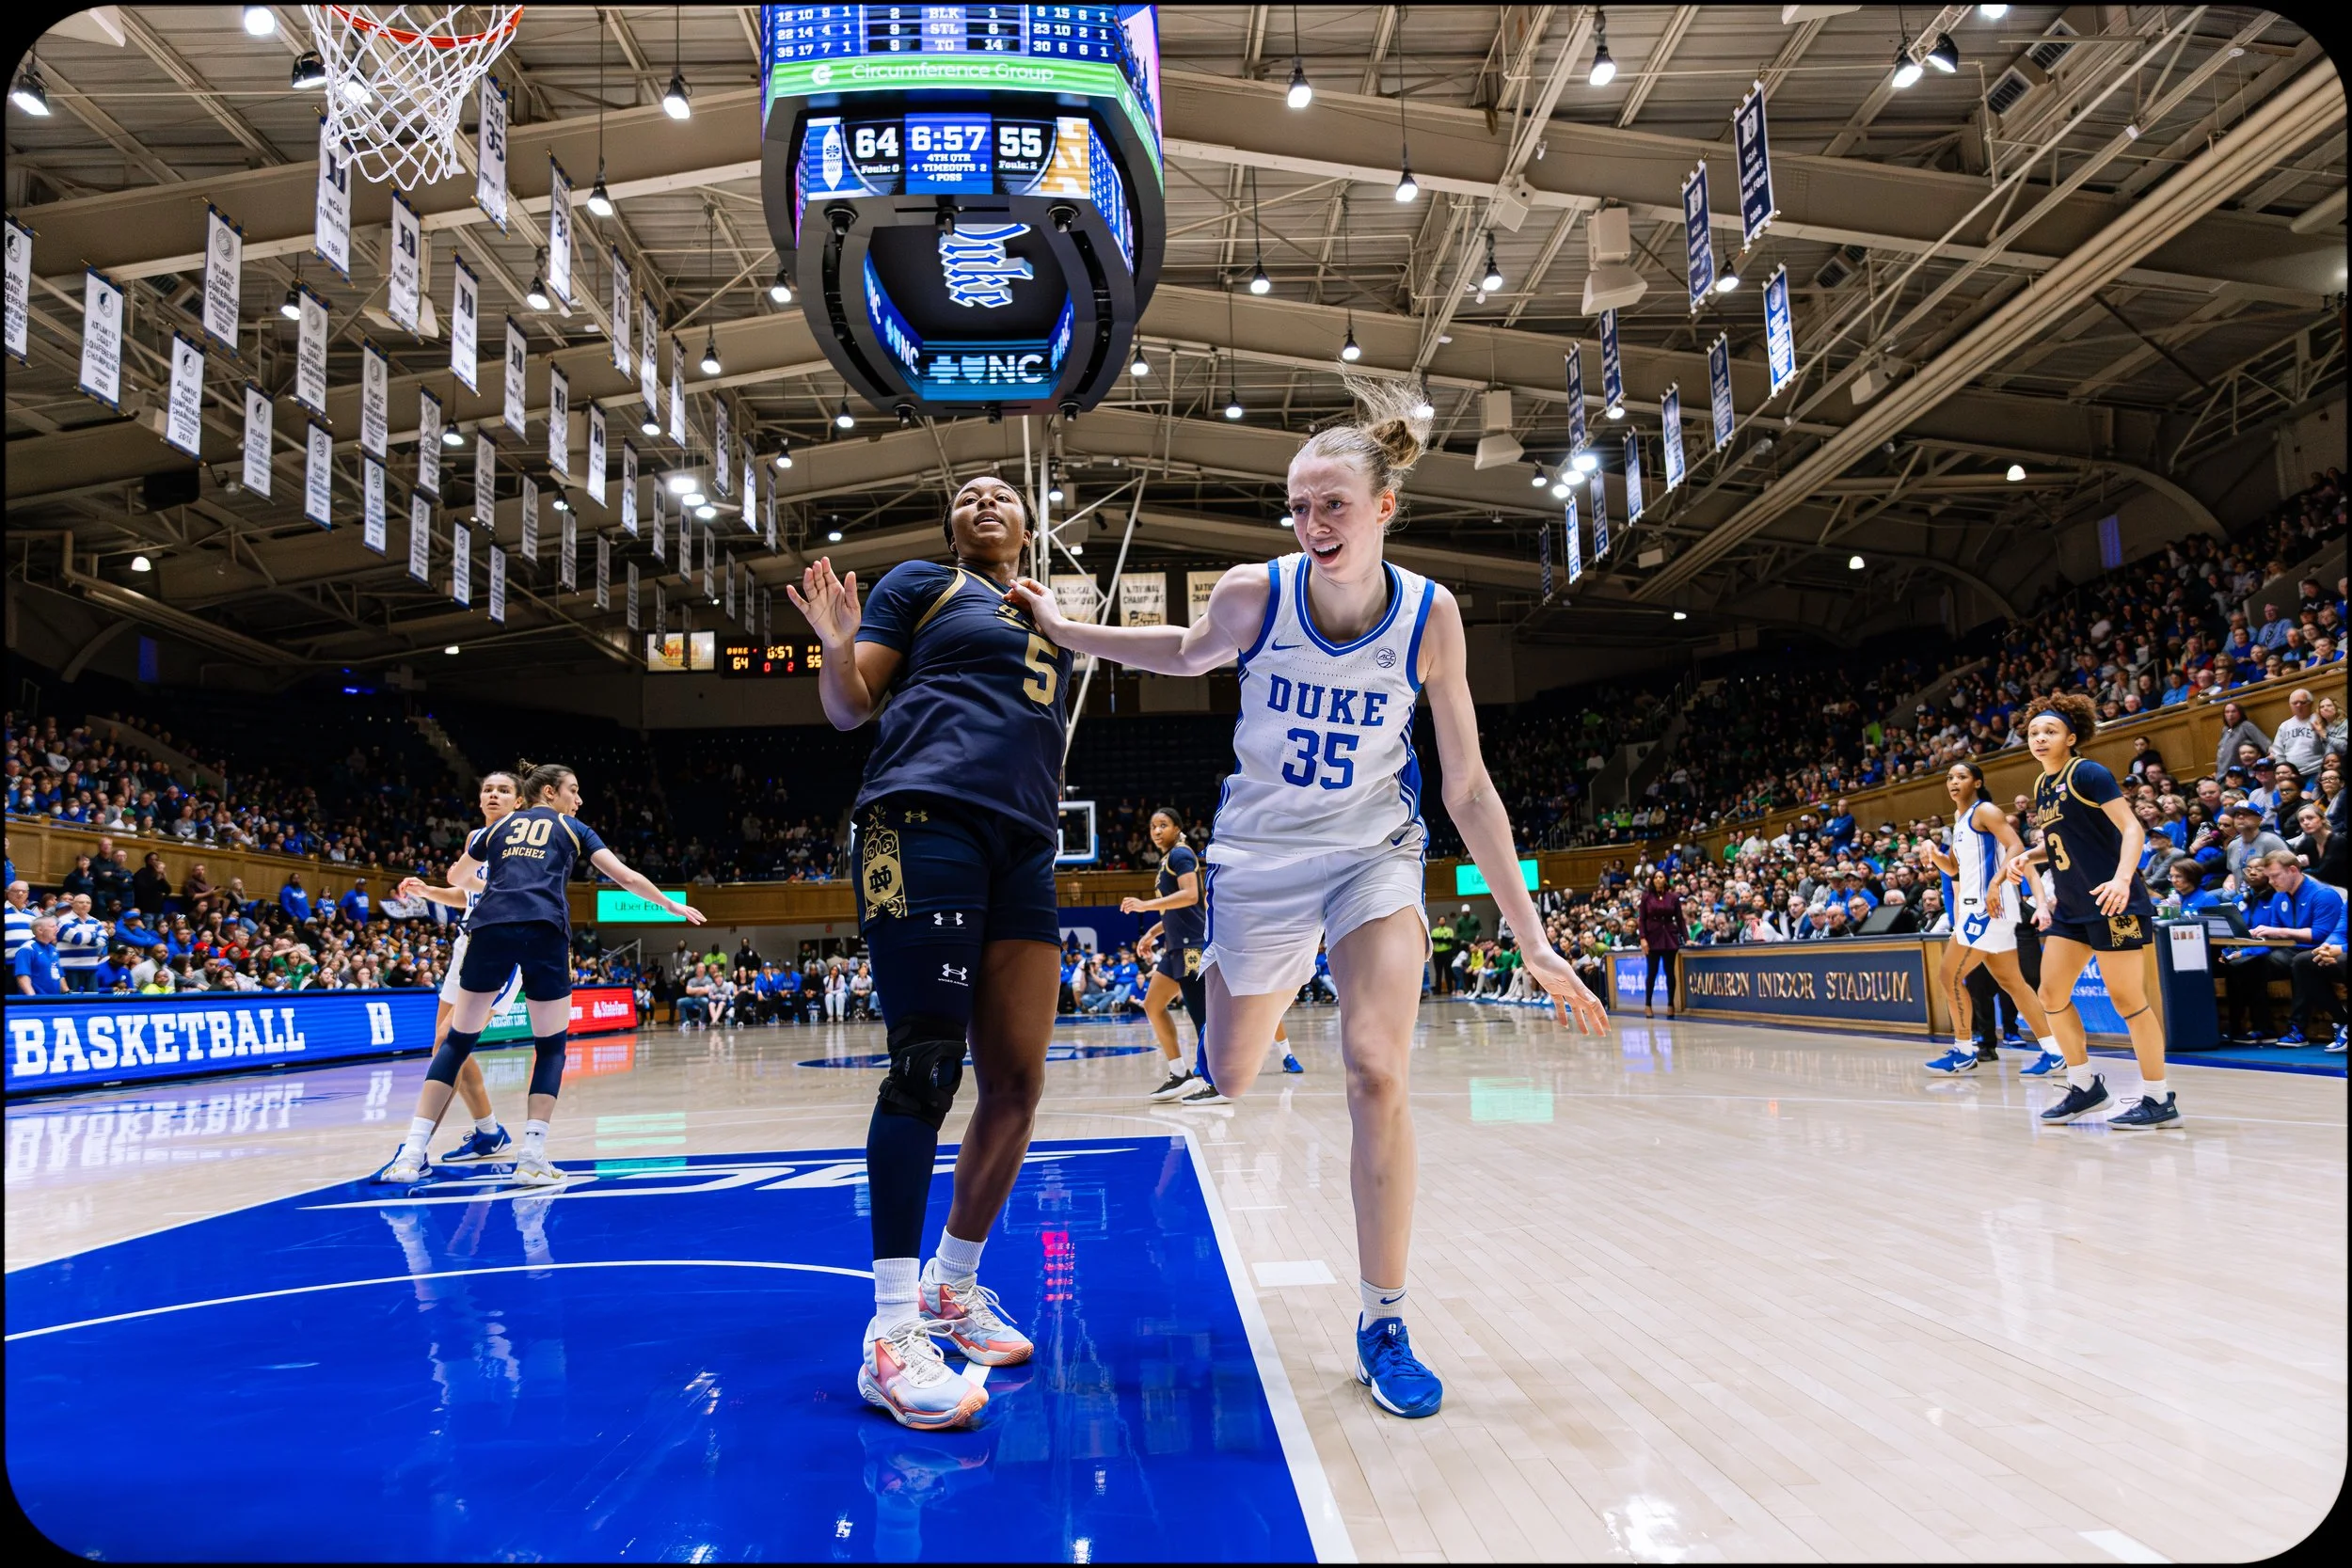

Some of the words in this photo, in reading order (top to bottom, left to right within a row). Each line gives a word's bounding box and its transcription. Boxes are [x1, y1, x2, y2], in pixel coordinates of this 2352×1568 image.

[777, 10, 793, 23] 12
[798, 8, 813, 21] 10
[843, 6, 851, 17] 1
[890, 8, 900, 19] 2
[929, 7, 960, 19] BLK
[989, 8, 998, 19] 1
[1054, 8, 1070, 19] 15
[1099, 12, 1107, 23] 1
[777, 28, 794, 40] 22
[798, 26, 814, 39] 14
[821, 24, 831, 36] 4
[843, 24, 851, 34] 1
[930, 24, 959, 35] STL
[1033, 24, 1050, 35] 23
[1055, 24, 1071, 37] 10
[1079, 27, 1089, 39] 2
[1100, 29, 1108, 40] 1
[777, 47, 794, 58] 35
[798, 44, 814, 56] 17
[821, 42, 831, 54] 7
[843, 41, 851, 52] 1
[935, 40, 955, 52] TO
[985, 39, 1003, 51] 14
[1033, 40, 1051, 52] 30
[1101, 46, 1109, 57] 1
[850, 61, 991, 81] Circumference
[995, 63, 1054, 82] Group
[855, 126, 899, 159] 64
[911, 125, 987, 151] 6:57
[998, 126, 1042, 158] 55
[927, 153, 949, 162] 4TH
[950, 153, 971, 163] QTR
[998, 160, 1029, 169] Fouls:
[1029, 161, 1038, 170] 2
[861, 165, 891, 174] Fouls:
[911, 164, 919, 172] 4
[922, 163, 976, 172] TIMEOUTS
[979, 163, 987, 172] 2
[936, 173, 962, 182] POSS
[989, 354, 1044, 384] NC
[726, 647, 749, 656] DUKE
[767, 645, 793, 659] 6:57
[732, 657, 749, 671] 64
[764, 662, 771, 673] 0
[787, 662, 794, 673] 2
[806, 655, 822, 669] 55
[1023, 632, 1059, 706] 5
[1267, 673, 1389, 727] DUKE
[1281, 726, 1359, 791] 35
[504, 817, 554, 847] 30
[501, 847, 547, 860] SANCHEZ
[2047, 832, 2071, 872] 3
[614, 901, 642, 911] Uber
[1689, 971, 1750, 998] CAMERON
[1757, 971, 1817, 1000] INDOOR
[1826, 970, 1914, 1004] STADIUM
[8, 1007, 306, 1077] BASKETBALL
